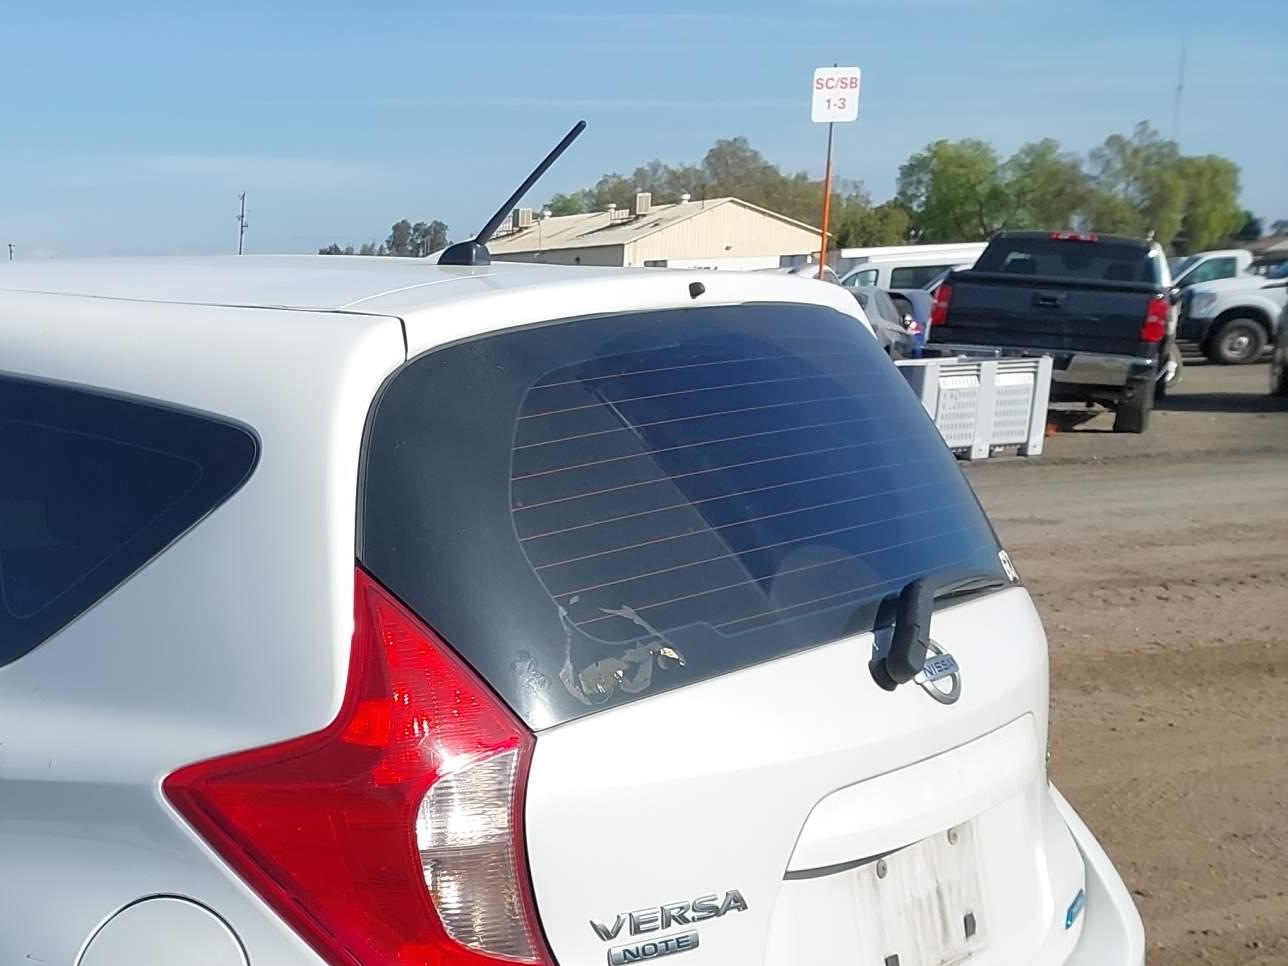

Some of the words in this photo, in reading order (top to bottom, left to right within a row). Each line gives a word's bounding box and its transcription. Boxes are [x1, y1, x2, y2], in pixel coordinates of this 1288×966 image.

[815, 77, 858, 90] SC/SB
[825, 97, 847, 110] 1-3
[923, 657, 955, 678] NISSA
[589, 889, 749, 942] VERSA
[622, 934, 691, 961] NOTE
